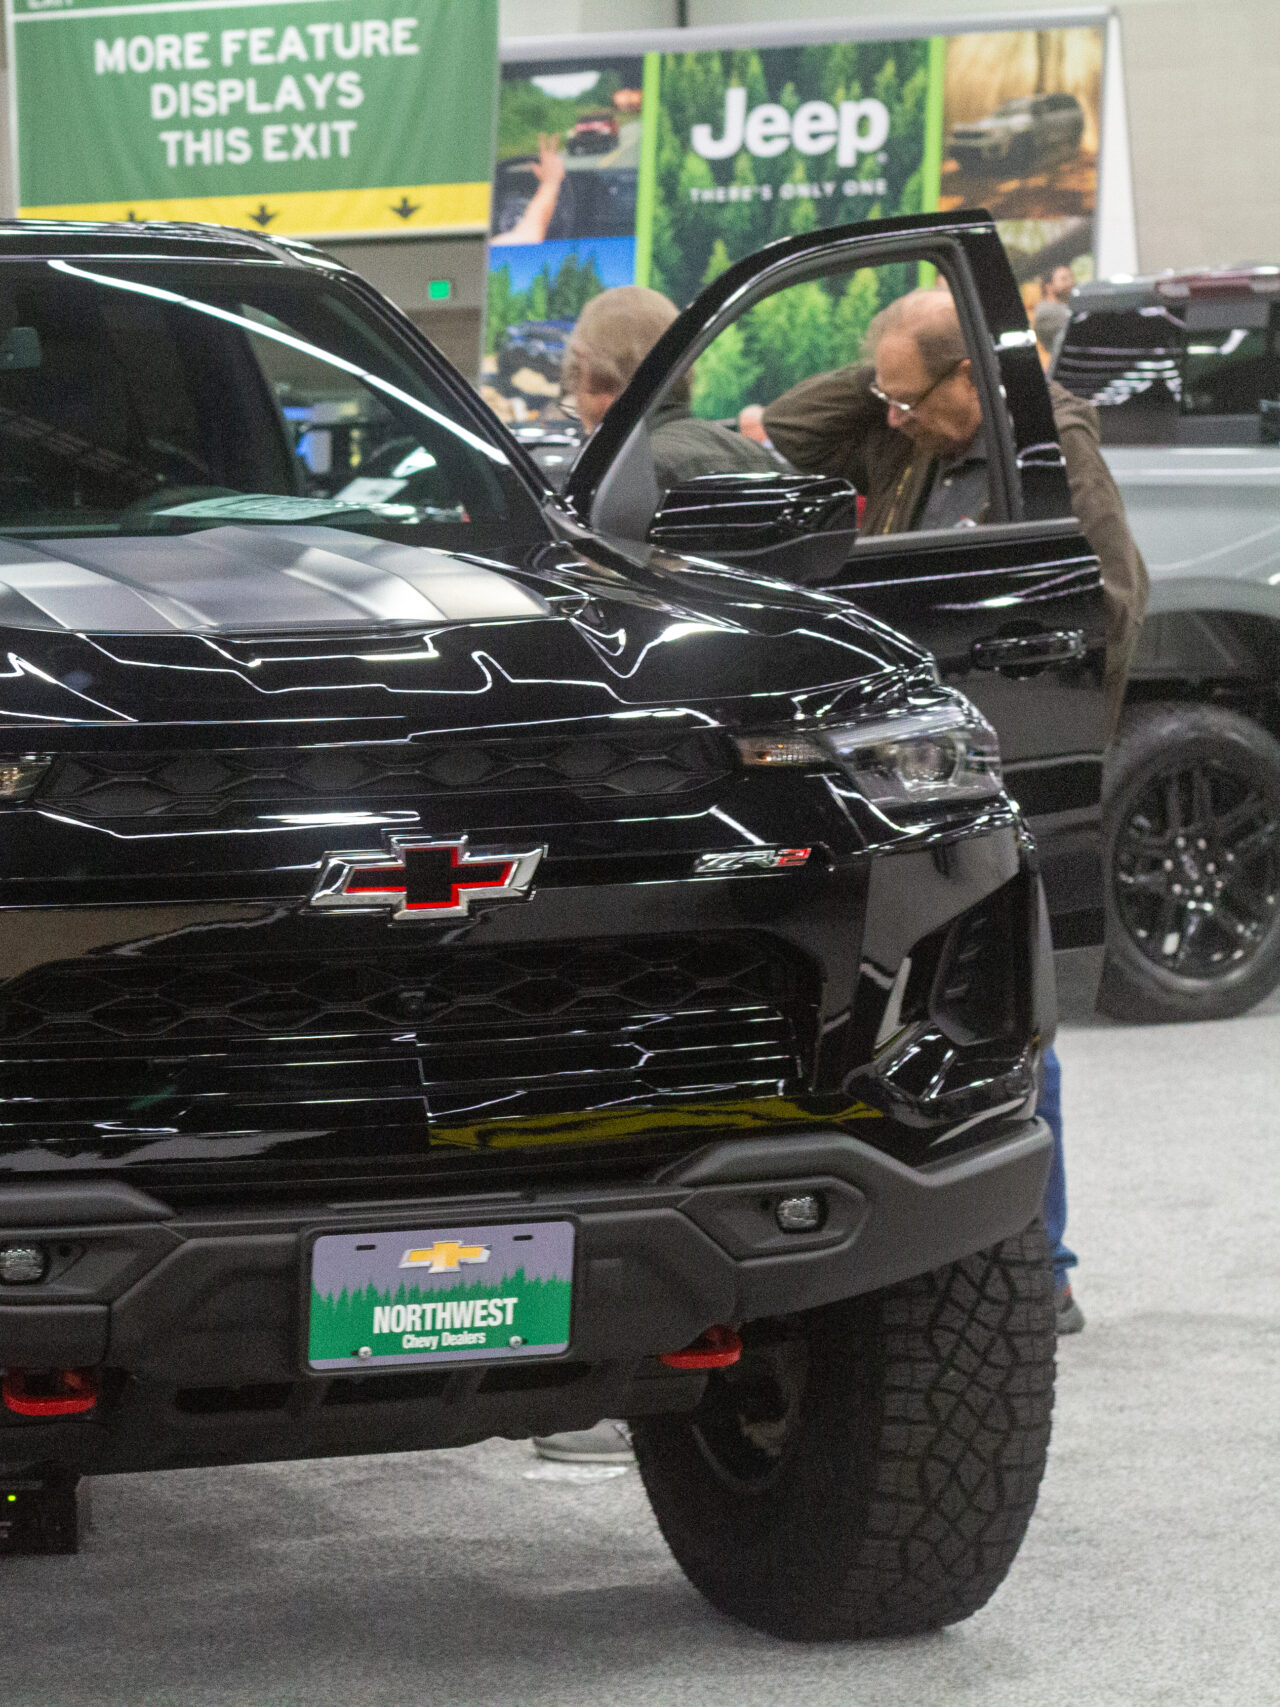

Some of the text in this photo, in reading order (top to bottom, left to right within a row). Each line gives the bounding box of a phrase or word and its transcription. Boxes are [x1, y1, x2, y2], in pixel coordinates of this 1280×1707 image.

[95, 18, 419, 74] MORE FEATURE
[150, 72, 364, 119] DISPLAYS
[159, 121, 357, 167] THIS EXIT
[691, 87, 890, 168] Jeep
[690, 178, 888, 203] THERE'S ONLY ONE
[694, 848, 811, 873] ZR2
[373, 1297, 518, 1334] NORTHWEST
[402, 1331, 486, 1350] Chevy Dealers
